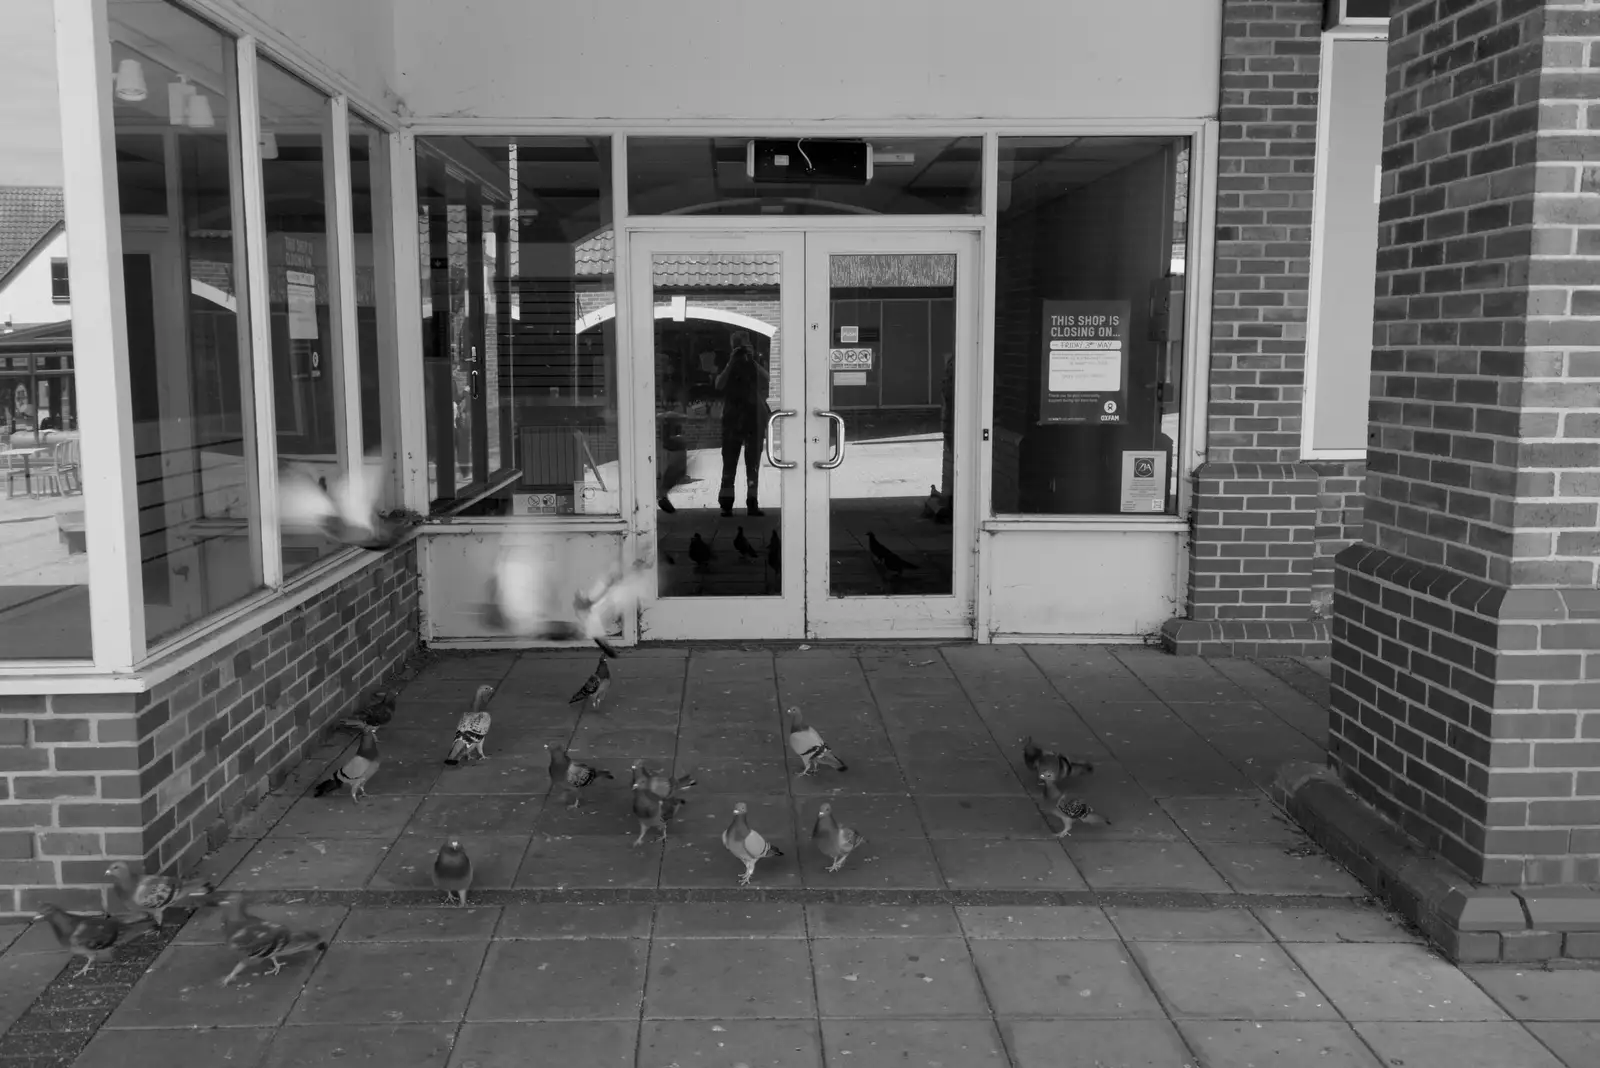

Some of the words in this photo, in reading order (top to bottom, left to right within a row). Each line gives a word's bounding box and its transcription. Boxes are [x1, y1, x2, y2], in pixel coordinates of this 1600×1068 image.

[1051, 315, 1075, 326] THIS
[1078, 315, 1106, 326] SHOP
[1109, 315, 1120, 326] IS
[1051, 327, 1095, 337] CLOSING
[1098, 327, 1121, 337] ON...
[1060, 341, 1083, 349] FRIDAY
[1096, 341, 1113, 349] MAY
